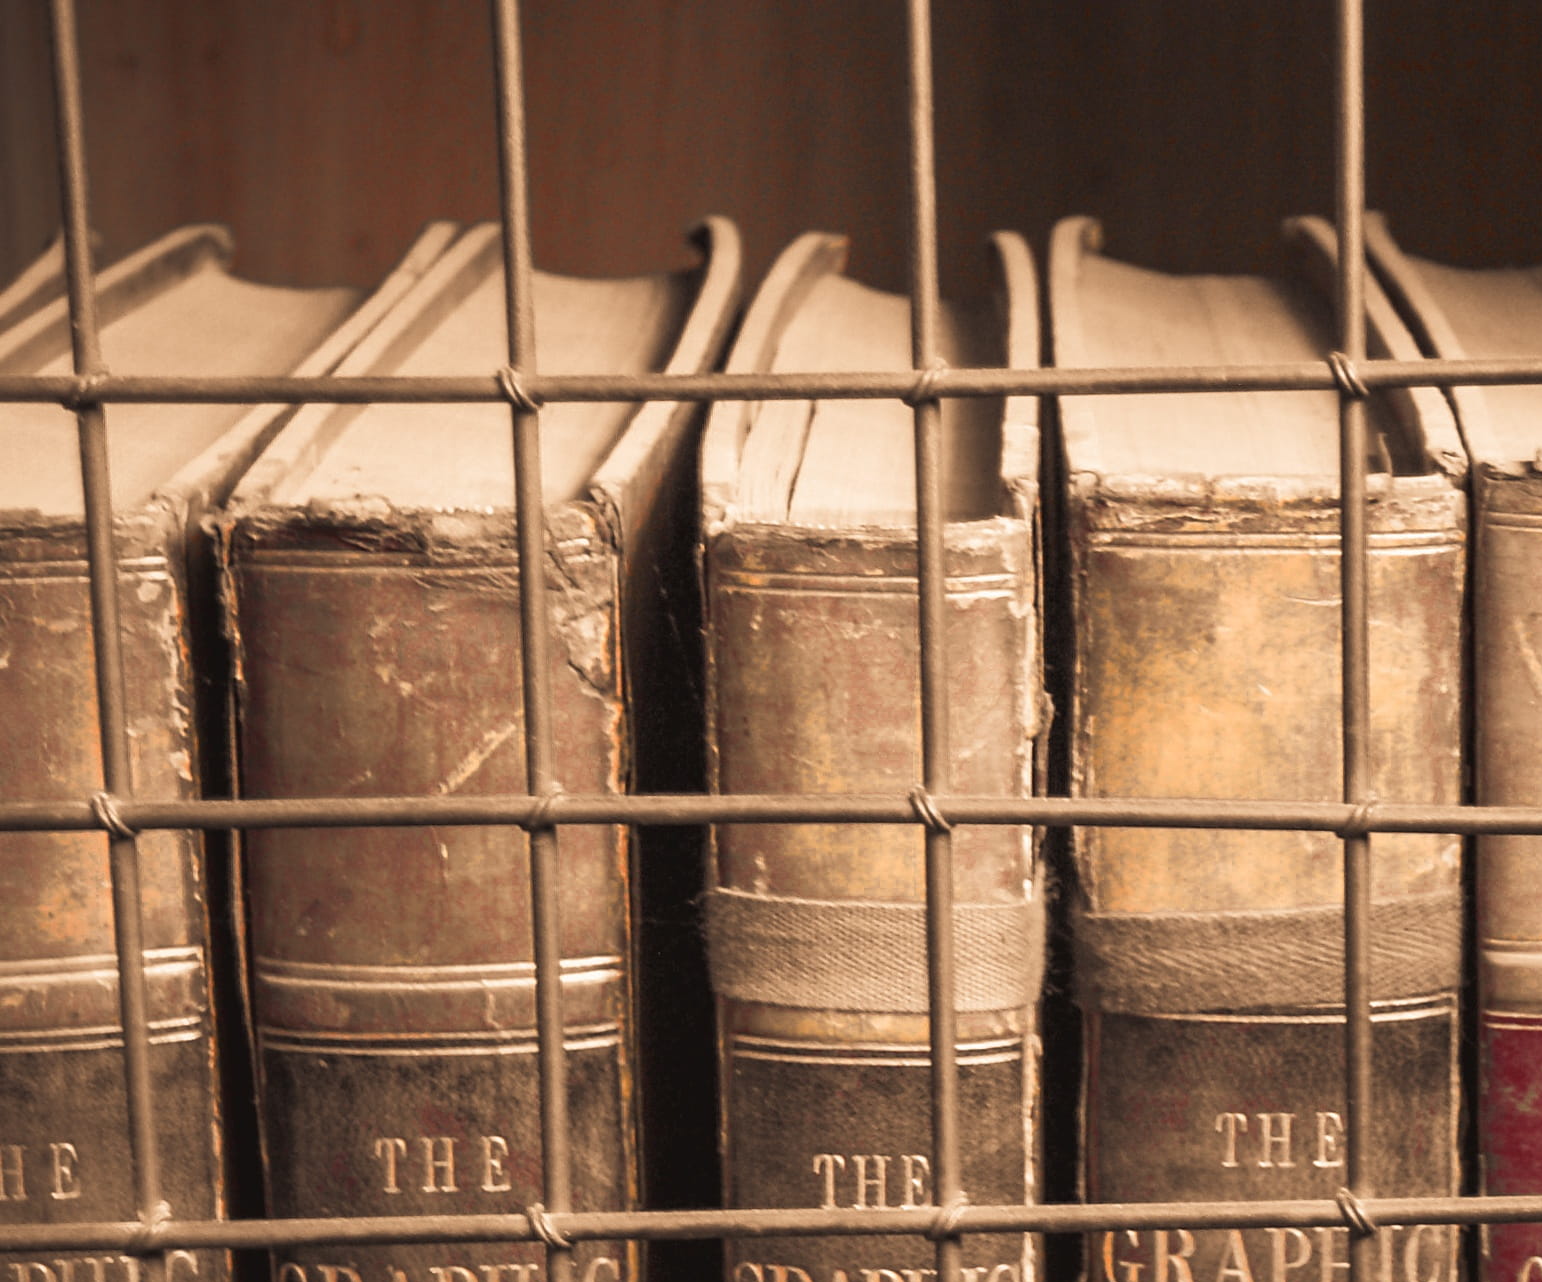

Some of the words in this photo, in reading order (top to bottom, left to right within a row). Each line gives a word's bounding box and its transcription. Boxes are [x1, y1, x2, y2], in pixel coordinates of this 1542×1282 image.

[374, 1135, 512, 1194] THE
[1215, 1112, 1344, 1168] THE
[813, 1153, 932, 1211] THE
